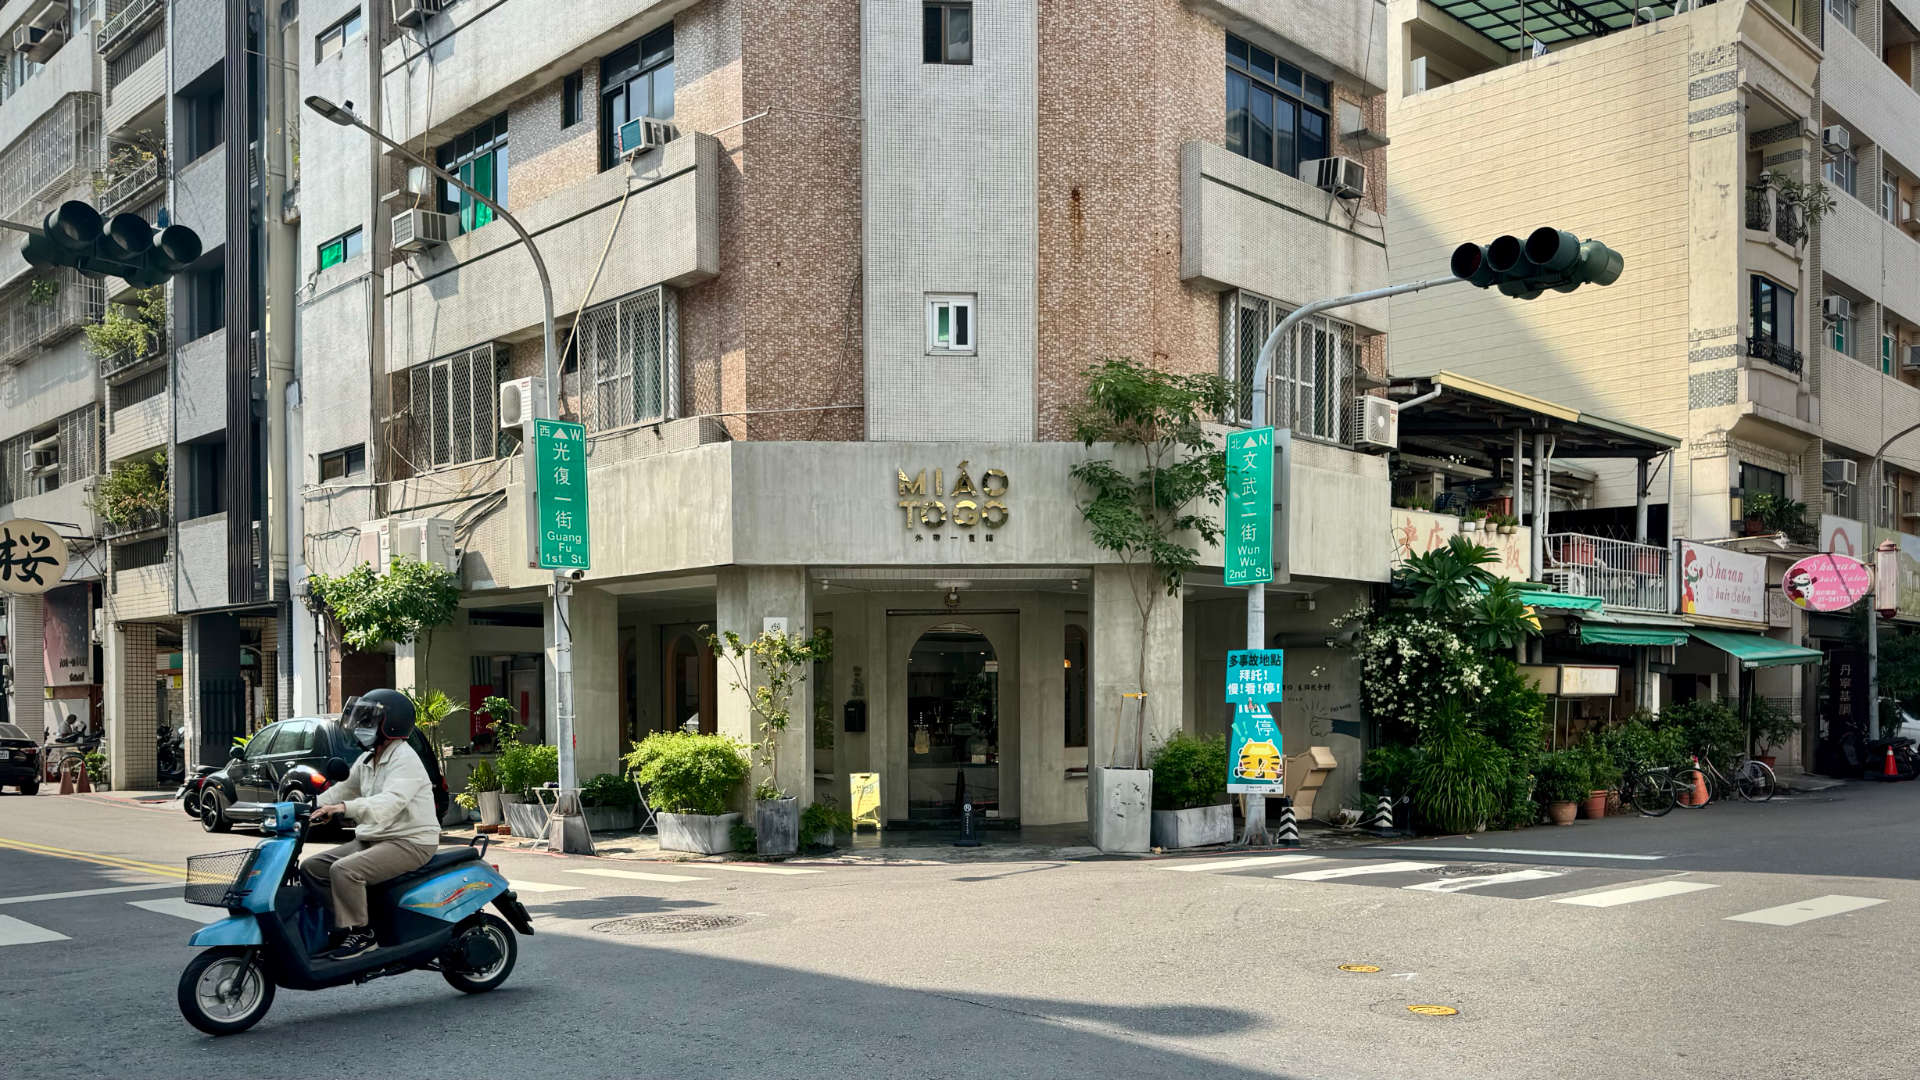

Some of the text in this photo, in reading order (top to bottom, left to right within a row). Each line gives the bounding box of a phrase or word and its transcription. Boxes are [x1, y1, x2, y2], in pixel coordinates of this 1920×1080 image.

[540, 425, 583, 442] 西 W.
[1231, 439, 1241, 450] 北
[553, 443, 572, 530] 光復一街
[1241, 451, 1258, 542] 文武二街
[898, 500, 1009, 530] TOGO
[547, 531, 582, 544] Guang
[558, 543, 572, 553] Fu
[1238, 546, 1260, 556] Wun
[545, 554, 585, 565] 1st St.
[1240, 557, 1256, 567] Wu
[1229, 567, 1269, 579] 2nd St.
[1229, 654, 1281, 667] 多事故地點
[1255, 720, 1274, 736] 停
